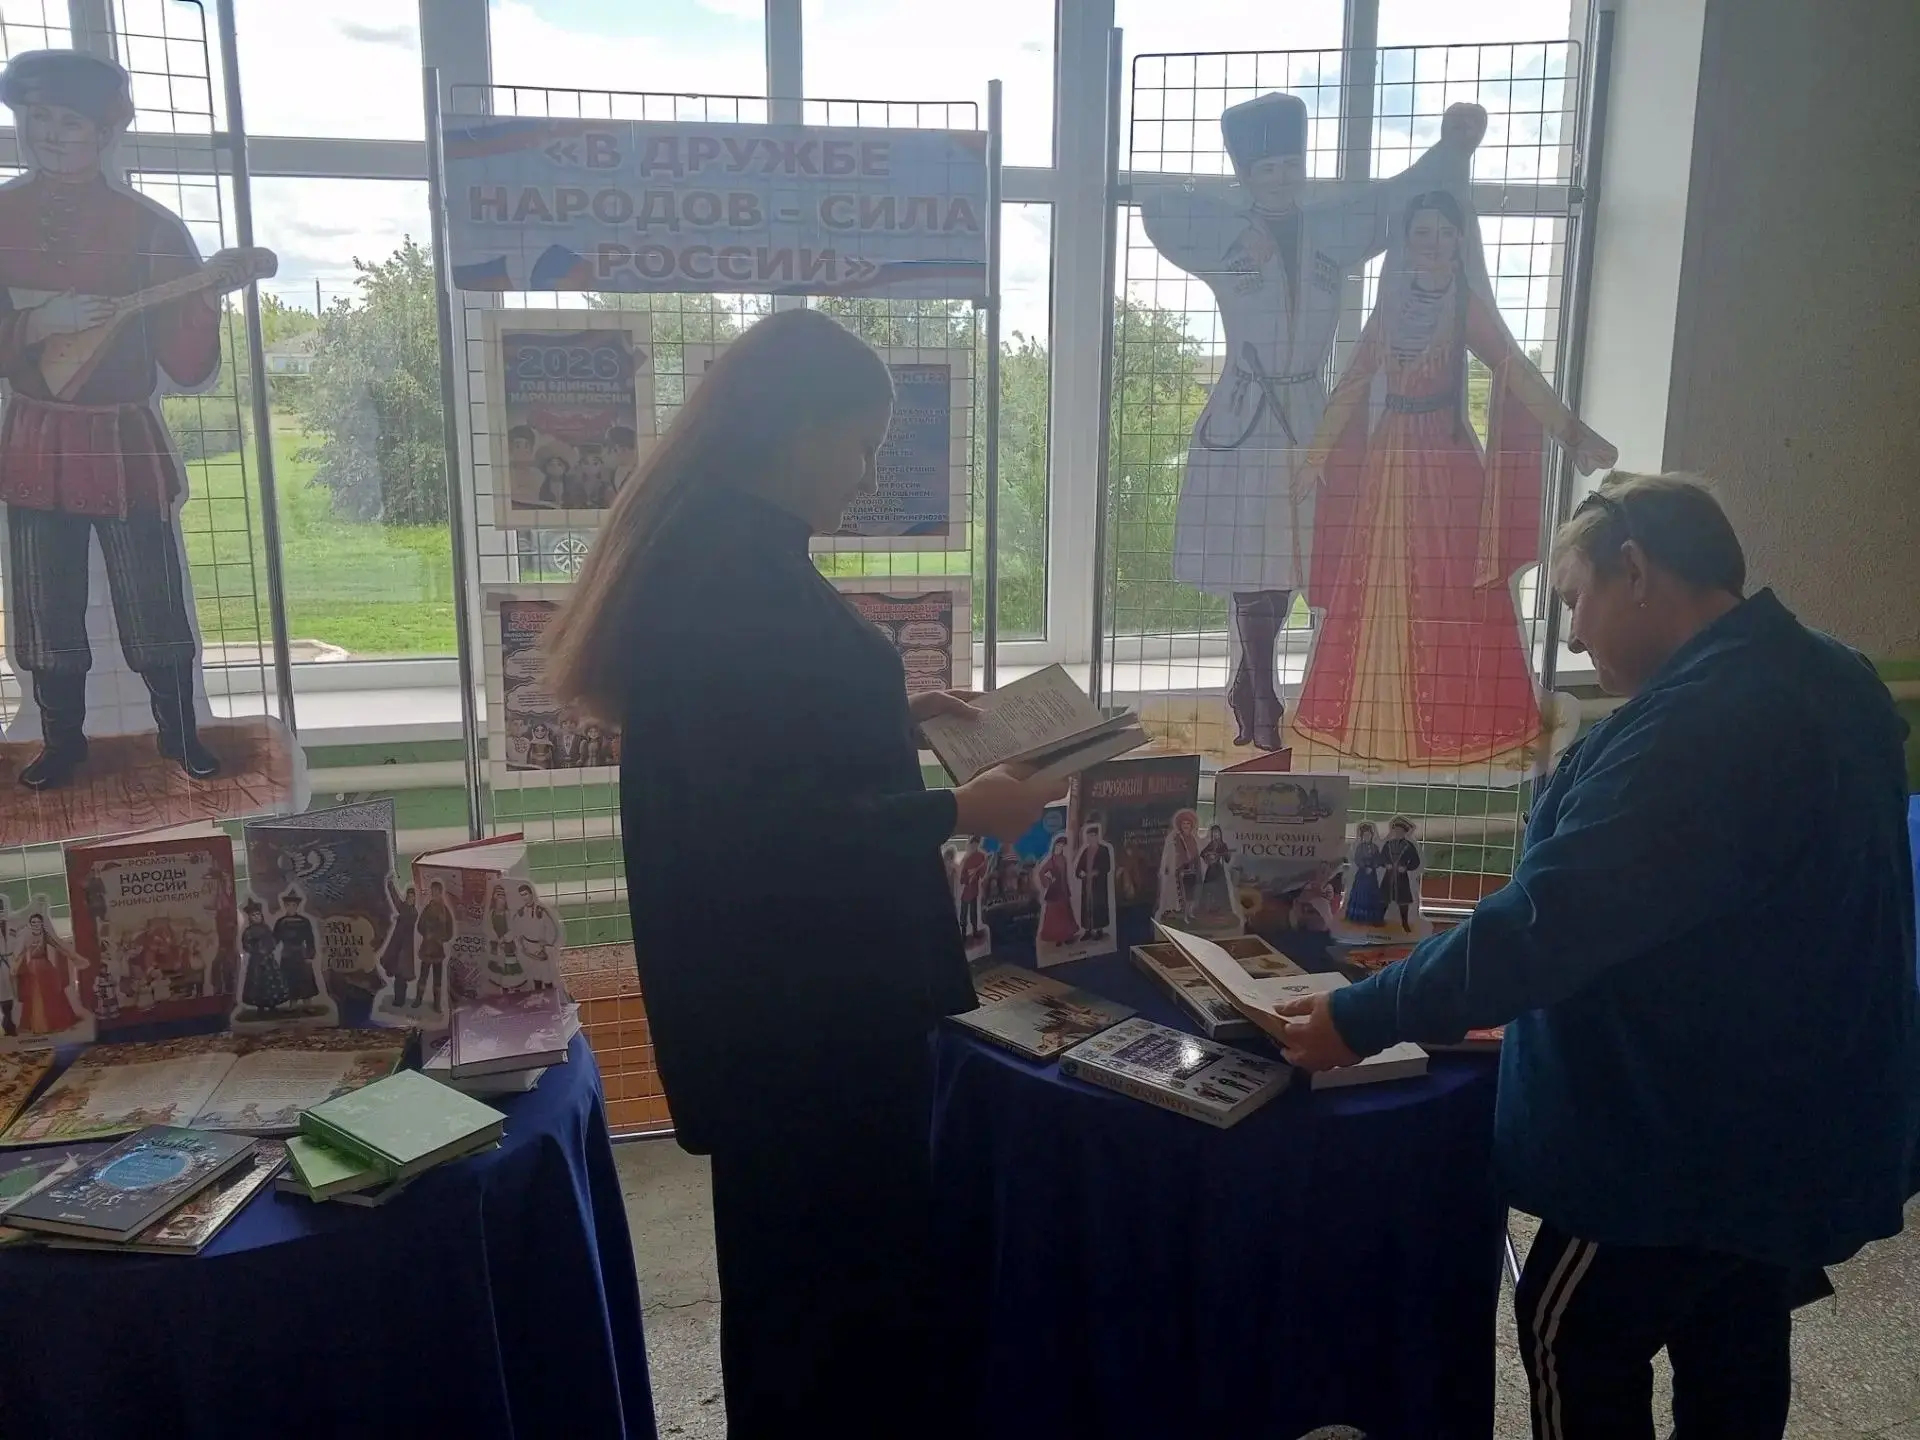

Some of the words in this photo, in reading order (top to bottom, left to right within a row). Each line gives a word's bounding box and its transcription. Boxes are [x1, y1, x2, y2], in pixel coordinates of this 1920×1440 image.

[544, 132, 621, 170] «В
[640, 136, 891, 178] ДРУЖБЕ
[469, 186, 763, 232] НАРОДОВ
[820, 196, 979, 232] СИЛА
[599, 243, 877, 284] РОССИИ»
[516, 345, 620, 380] 2026
[1240, 842, 1316, 856] РОССИЯ
[119, 867, 187, 885] НАРОДЫ
[121, 880, 188, 897] РОССИИ
[109, 890, 201, 907] ЭНЦИКЛОПЕДИЯ
